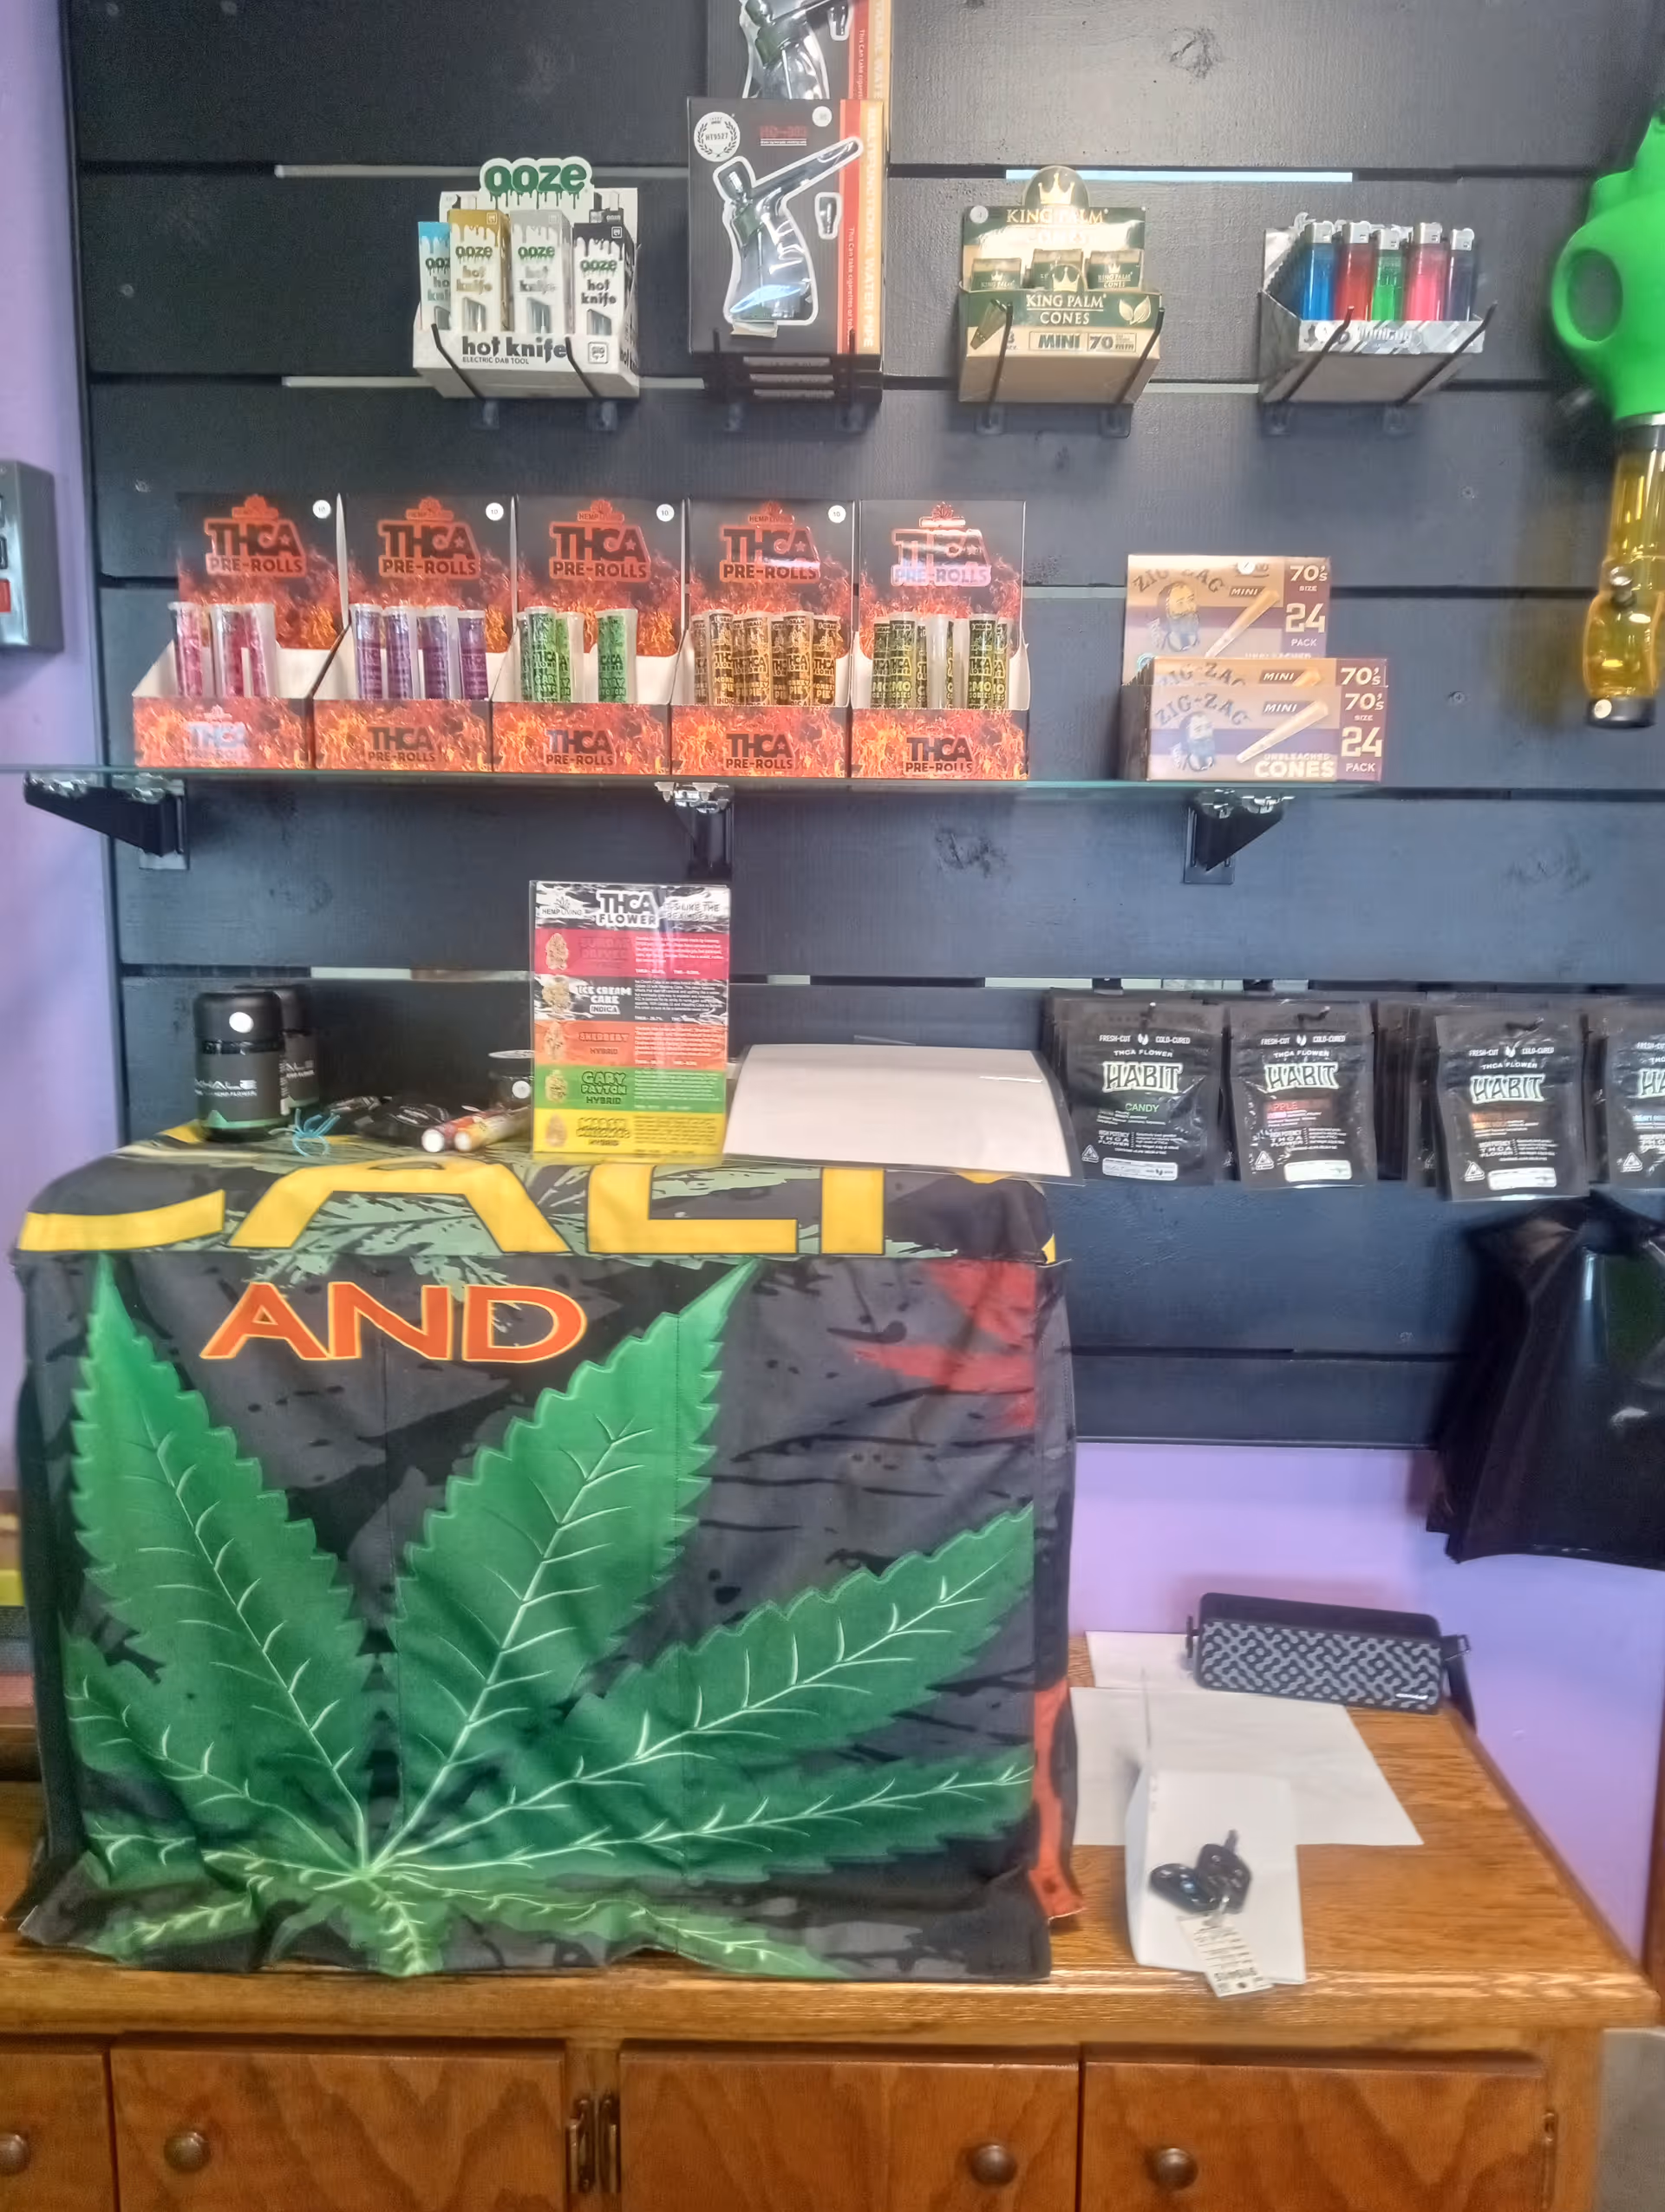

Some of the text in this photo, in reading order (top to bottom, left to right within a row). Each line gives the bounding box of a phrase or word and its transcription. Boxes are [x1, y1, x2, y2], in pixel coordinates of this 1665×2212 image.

[483, 163, 587, 206] ooze
[1006, 209, 1053, 223] KING
[455, 246, 493, 260] ooze
[518, 246, 555, 259] ooze
[425, 258, 450, 272] ooz
[580, 260, 617, 274] ooze
[434, 276, 450, 288] ho
[587, 279, 610, 290] hot
[864, 258, 875, 310] WATER
[581, 292, 617, 307] knife
[1026, 294, 1103, 308] KING PALM
[1040, 312, 1090, 325] CONES
[863, 314, 874, 348] PIPE
[1038, 333, 1081, 349] MINI
[1089, 336, 1114, 349] 70
[462, 336, 567, 363] hot knife
[208, 524, 301, 556] THCA
[382, 525, 476, 558] THCA
[553, 525, 646, 562] THCA
[724, 528, 816, 563] THCA
[896, 531, 989, 565] THCA
[210, 558, 303, 573] PRE-ROLLS
[383, 559, 476, 575] PRE-ROLLS
[553, 563, 646, 578] PRE-ROLLS
[723, 564, 816, 579] PRE-ROLLS
[1290, 565, 1329, 582] 70's
[894, 568, 988, 584] PRE-ROLLS
[1231, 587, 1257, 596] MINI
[1285, 603, 1326, 633] 24
[1263, 672, 1295, 681] MINI
[1340, 667, 1381, 686] 70's
[1154, 692, 1251, 727] ZIG-ZAG
[1263, 703, 1296, 713] MINI
[1344, 692, 1384, 711] 70's
[367, 727, 434, 750] THCA
[547, 729, 614, 754] THCA
[727, 734, 793, 758] THCA
[1341, 727, 1382, 757] 24
[368, 752, 435, 762] PRE-ROLLS
[906, 737, 973, 761] THCA
[546, 755, 613, 765] PRE-ROLLS
[726, 759, 793, 769] PRE-ROLLS
[905, 762, 972, 773] PRE-ROLLS
[1346, 763, 1375, 772] PACK
[1255, 760, 1335, 778] CONES
[599, 893, 655, 914] THCA
[702, 903, 720, 911] THE
[599, 914, 656, 924] FLOWER
[582, 1071, 626, 1085] GARY
[1103, 1062, 1183, 1093] HABIT
[1264, 1062, 1339, 1093] HABIT
[581, 1084, 627, 1095] PAYTON
[1470, 1073, 1545, 1104] HABIT
[1126, 1103, 1160, 1113] CANDY
[199, 1281, 586, 1364] AND
